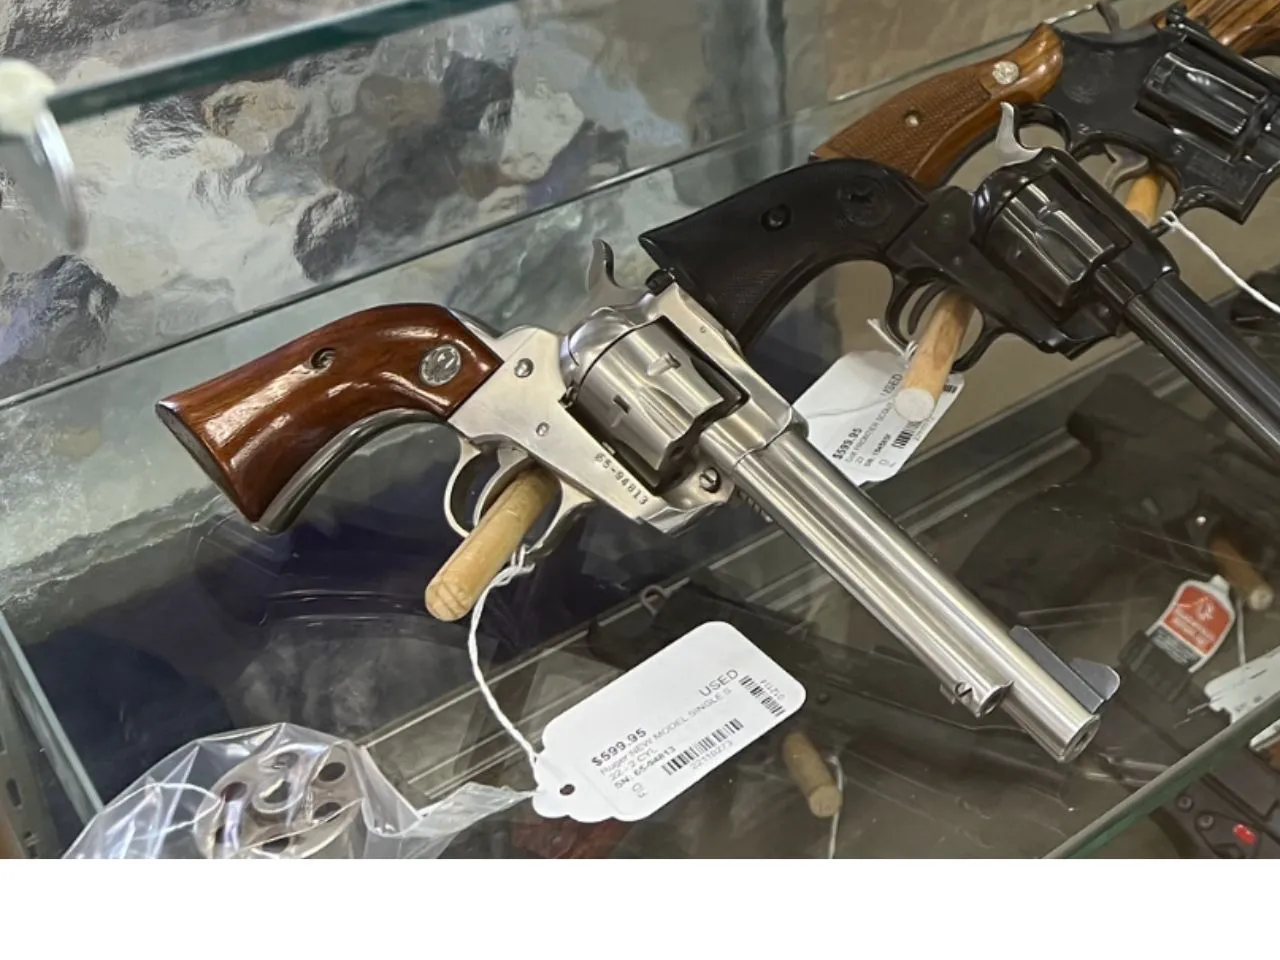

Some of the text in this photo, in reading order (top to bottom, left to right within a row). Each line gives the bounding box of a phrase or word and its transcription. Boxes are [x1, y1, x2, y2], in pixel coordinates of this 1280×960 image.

[594, 452, 649, 506] 65-94813
[591, 727, 647, 766] $599.95
[699, 669, 738, 697] USED
[653, 714, 689, 739] MODEL
